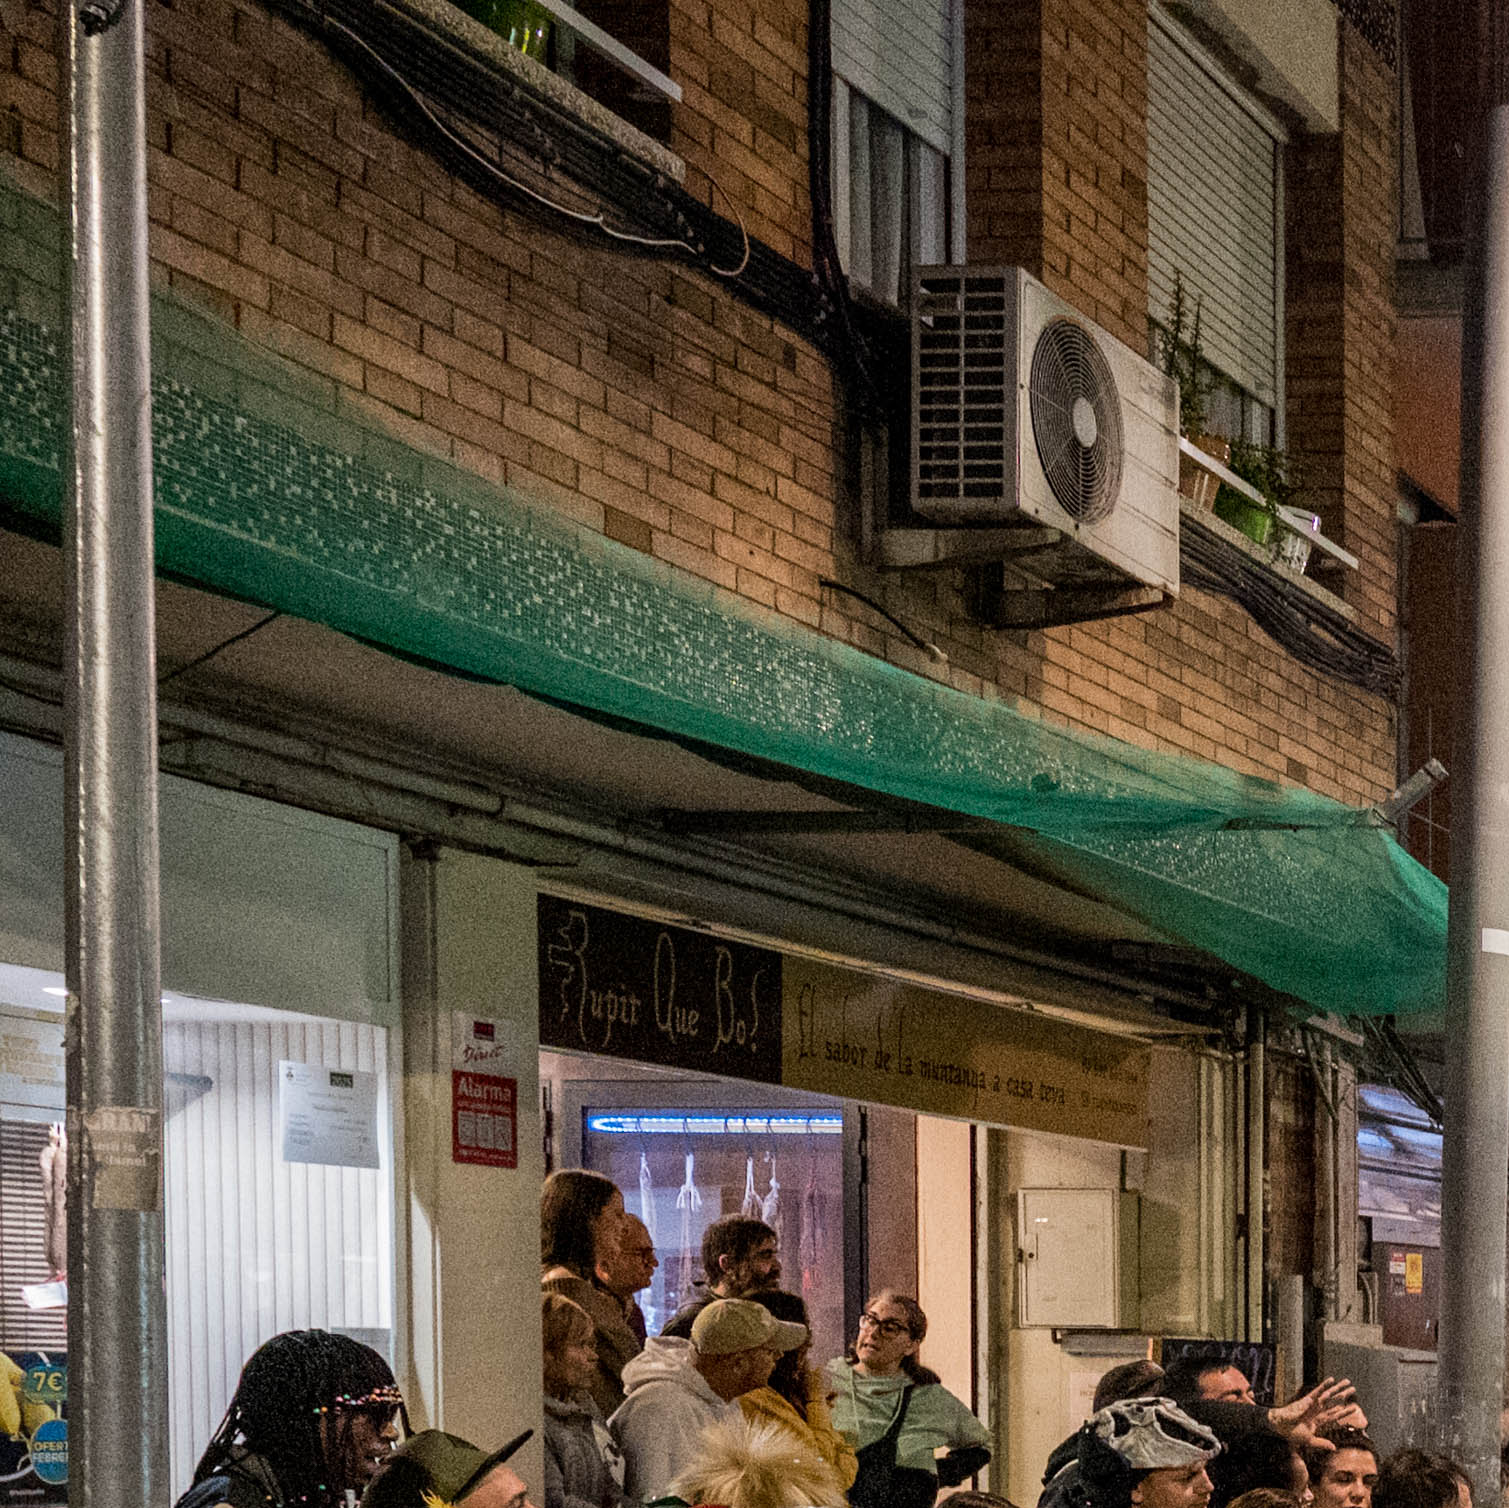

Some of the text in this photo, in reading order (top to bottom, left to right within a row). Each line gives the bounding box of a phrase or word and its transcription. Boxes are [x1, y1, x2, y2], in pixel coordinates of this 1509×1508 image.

[654, 931, 701, 1045] Que
[798, 982, 818, 1059] El
[823, 995, 869, 1069] sabor
[1006, 1076, 1035, 1100] casa
[457, 1076, 513, 1103] Alarma
[32, 1372, 63, 1392] 7€
